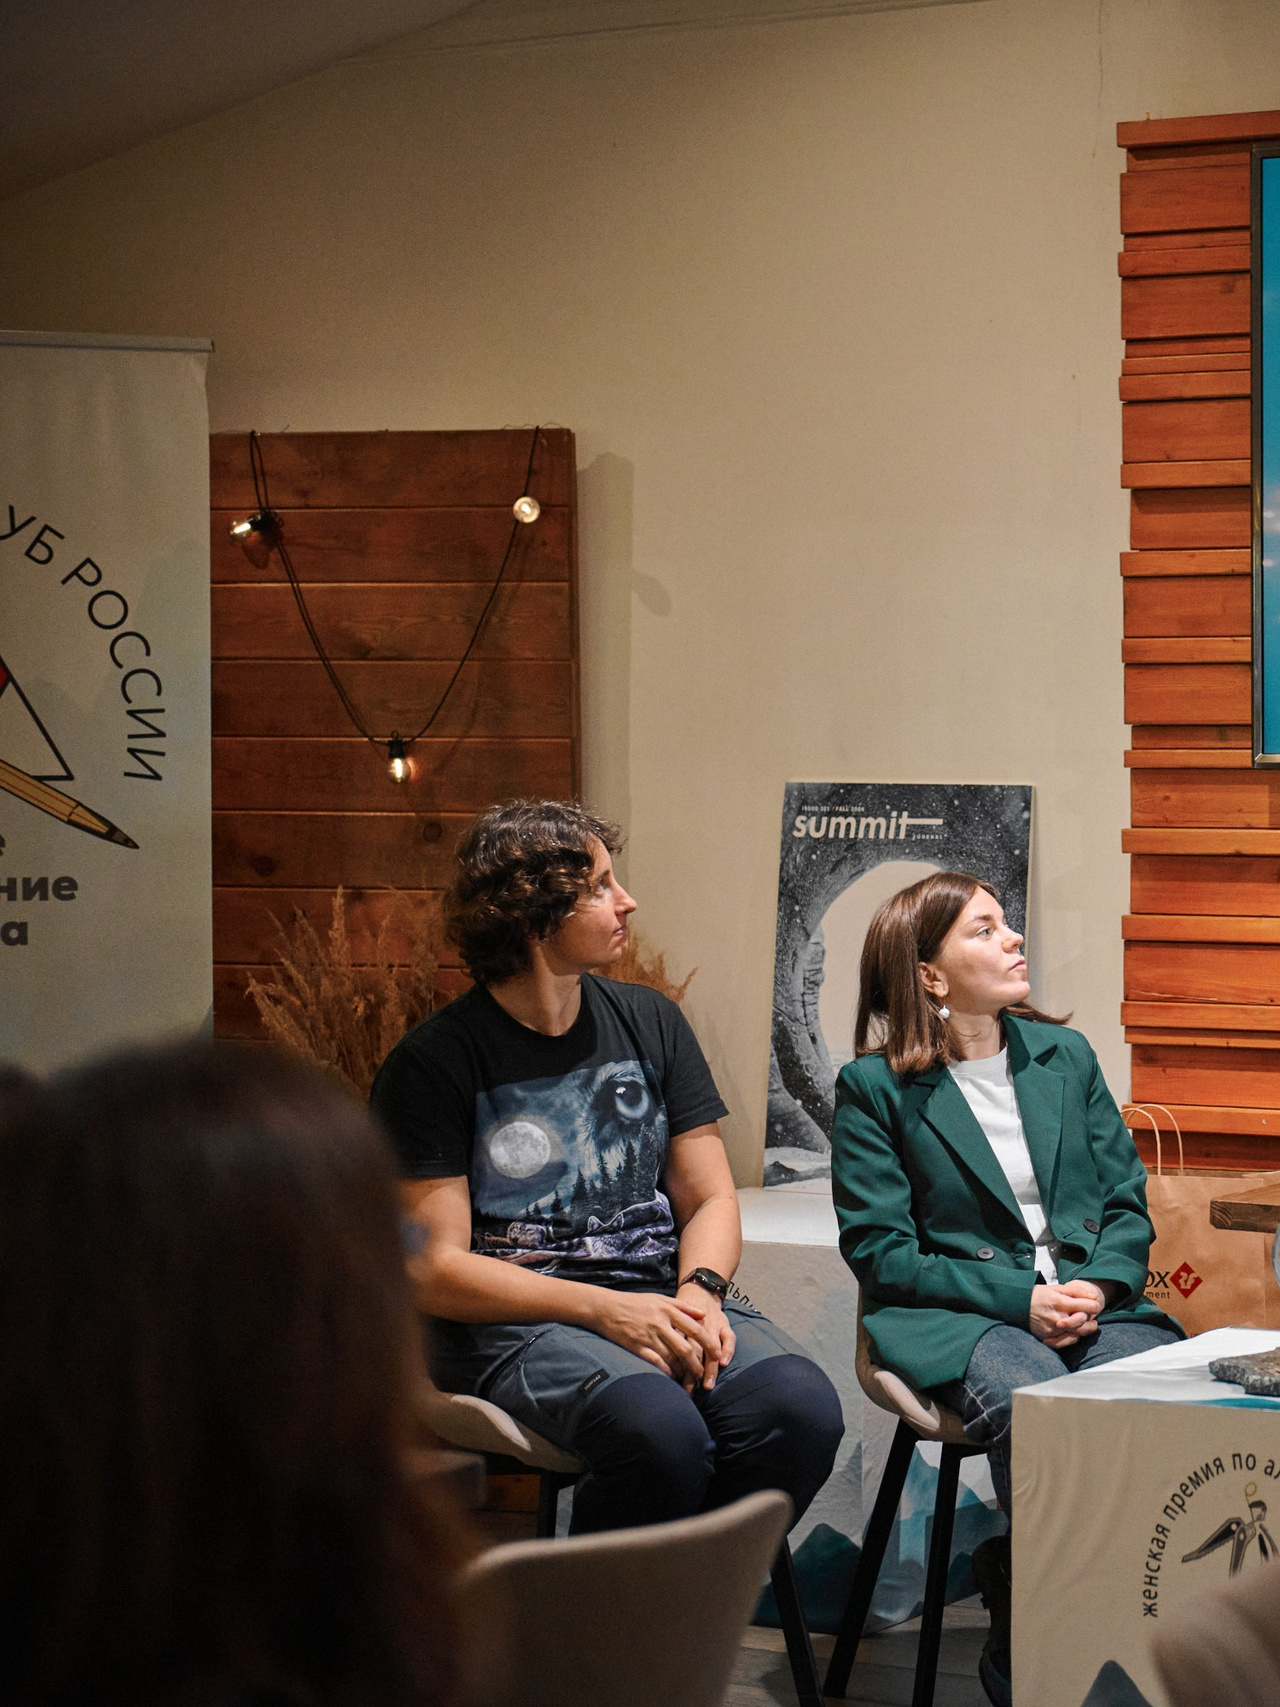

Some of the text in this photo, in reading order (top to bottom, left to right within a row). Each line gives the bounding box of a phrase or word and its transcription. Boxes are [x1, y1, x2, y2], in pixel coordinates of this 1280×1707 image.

[61, 557, 167, 781] РОССИИ
[792, 811, 944, 839] summit
[1142, 1523, 1171, 1618] женская
[1163, 1457, 1225, 1521] премия
[1232, 1453, 1257, 1470] по
